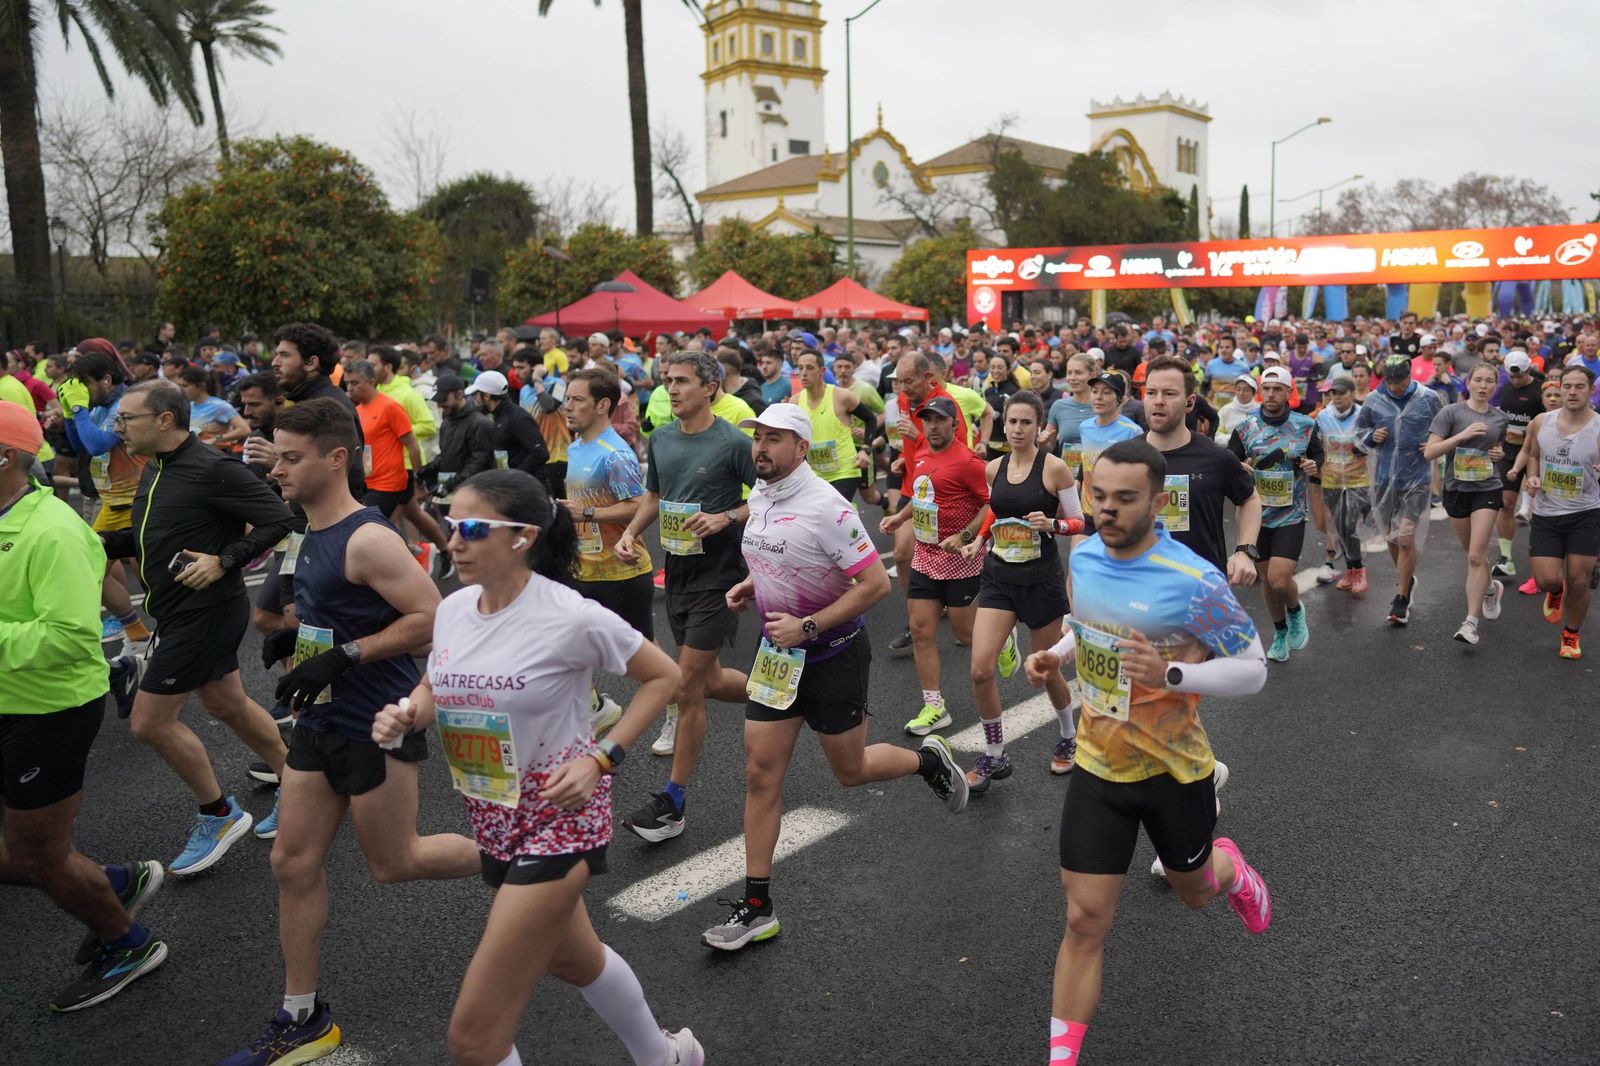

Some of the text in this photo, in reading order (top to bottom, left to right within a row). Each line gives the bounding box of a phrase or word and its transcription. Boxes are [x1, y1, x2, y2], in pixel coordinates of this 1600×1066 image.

[1547, 471, 1577, 486] 10649
[432, 672, 527, 691] UATRECASAS
[466, 693, 495, 709] Club
[444, 730, 502, 763] 12779
